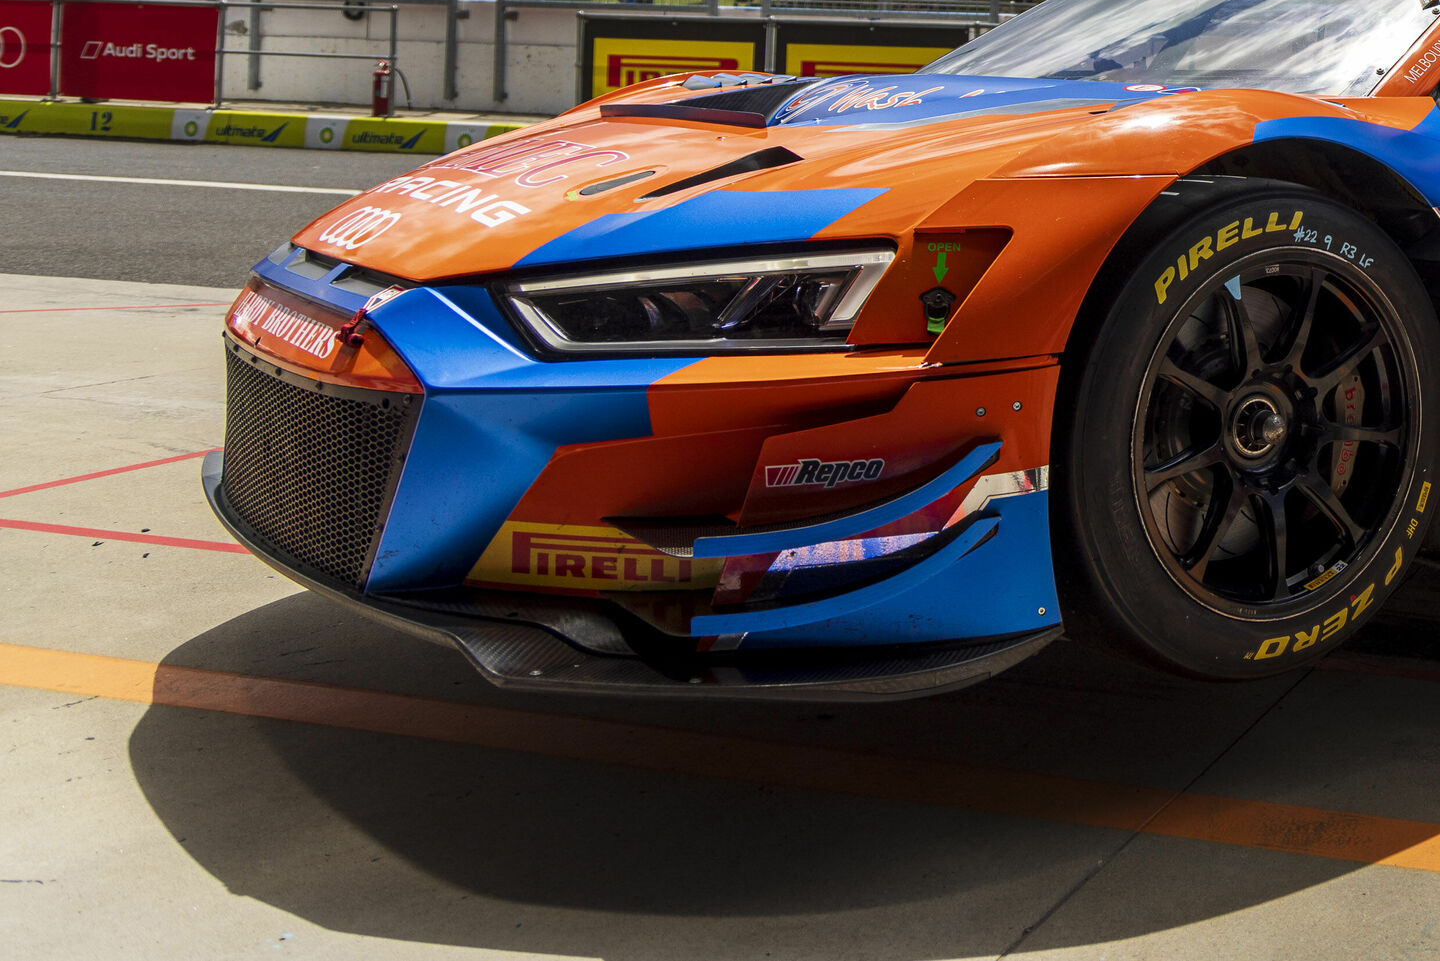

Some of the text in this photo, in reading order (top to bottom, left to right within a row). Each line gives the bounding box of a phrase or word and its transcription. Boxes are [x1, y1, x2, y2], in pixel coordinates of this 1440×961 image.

[102, 43, 196, 62] Audi Sport
[90, 111, 113, 131] 12
[215, 124, 266, 139] ultimate
[352, 131, 405, 146] ultimate
[374, 176, 532, 228] RACING
[927, 242, 960, 252] OPEN
[1154, 211, 1304, 304] PIRELLI
[1293, 226, 1318, 243] #22
[1340, 242, 1357, 259] R3
[233, 291, 341, 359] HARDY BROTHERS
[793, 458, 885, 489] Repco
[511, 531, 692, 583] PIRELLI
[1254, 546, 1403, 661] P ZERO
